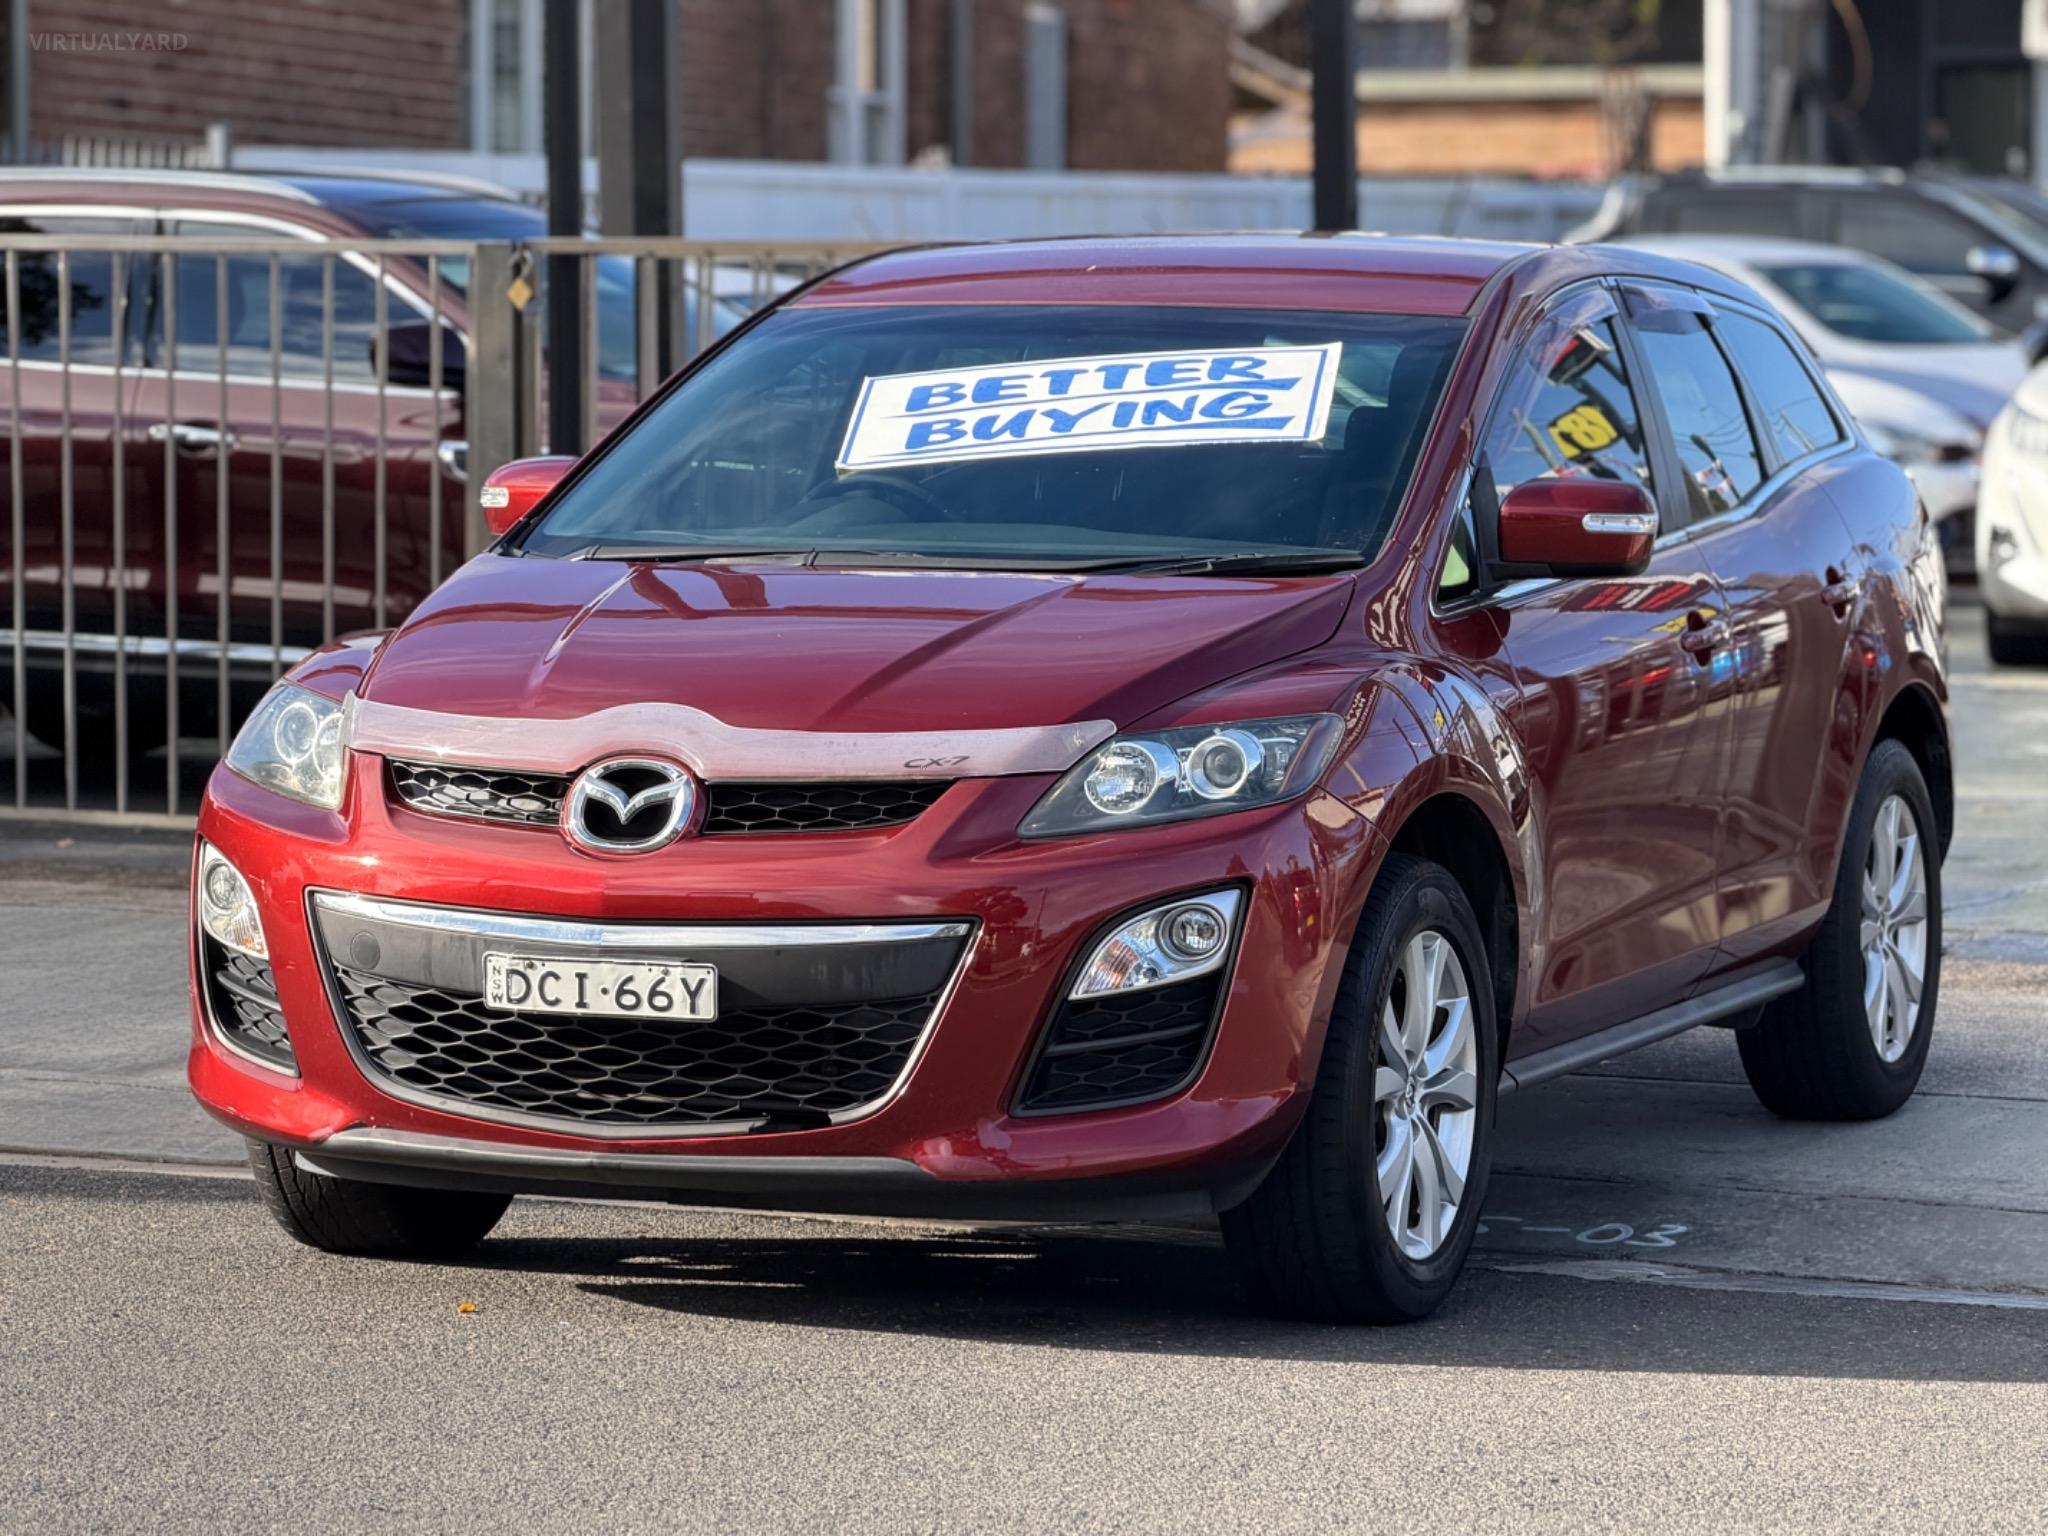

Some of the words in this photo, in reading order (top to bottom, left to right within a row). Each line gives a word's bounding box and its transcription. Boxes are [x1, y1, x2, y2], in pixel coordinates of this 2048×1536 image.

[905, 356, 1268, 412] BETTER
[905, 391, 1273, 450] BUYING
[903, 755, 970, 768] CX-7
[491, 965, 504, 1003] NSW
